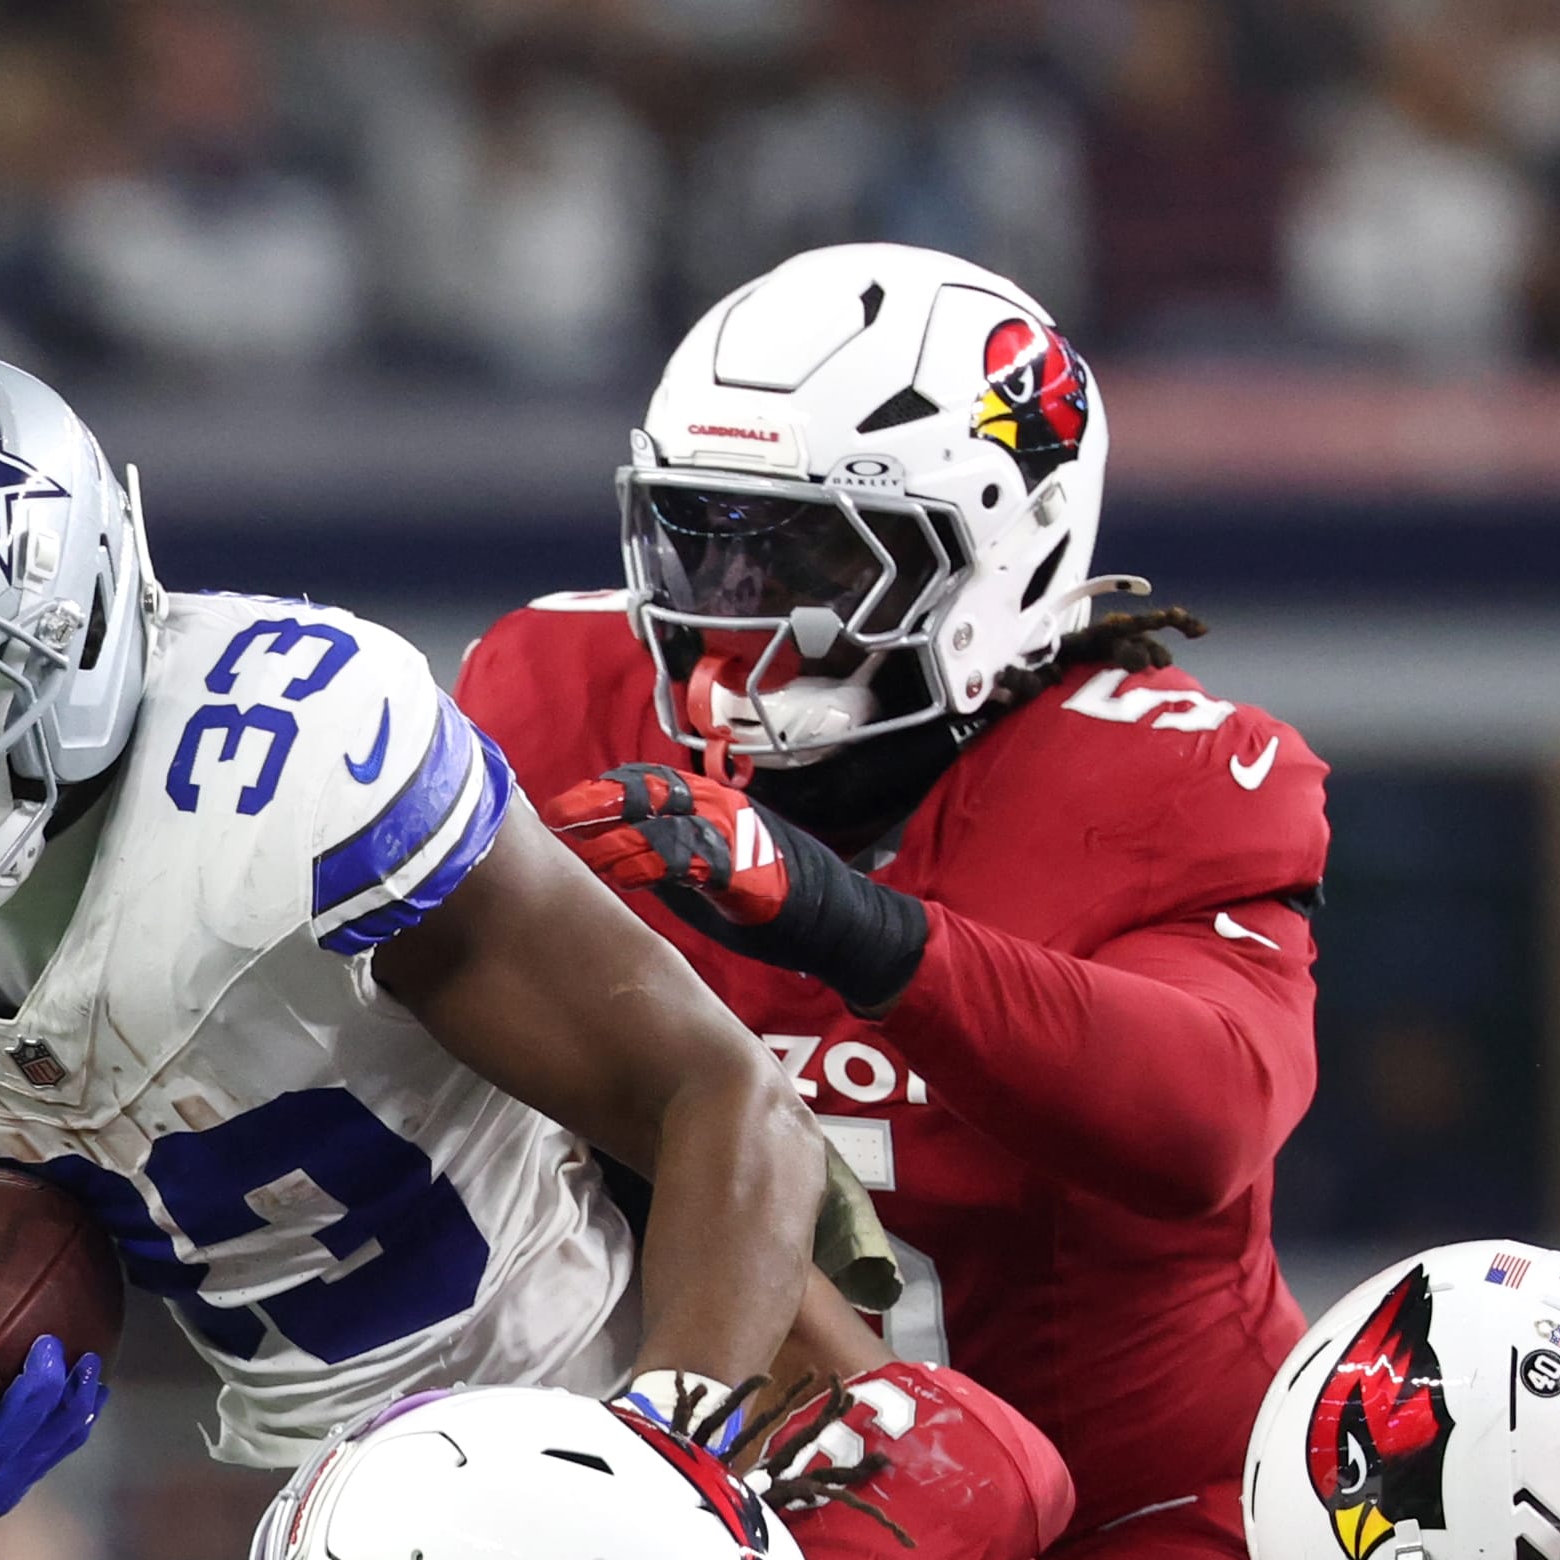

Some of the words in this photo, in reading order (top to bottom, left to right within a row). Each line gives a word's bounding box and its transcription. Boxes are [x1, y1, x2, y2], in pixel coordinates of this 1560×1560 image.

[688, 424, 779, 442] CARDINALS
[833, 477, 901, 488] OAKLEY
[166, 617, 360, 816] 33
[1061, 668, 1238, 732] 5
